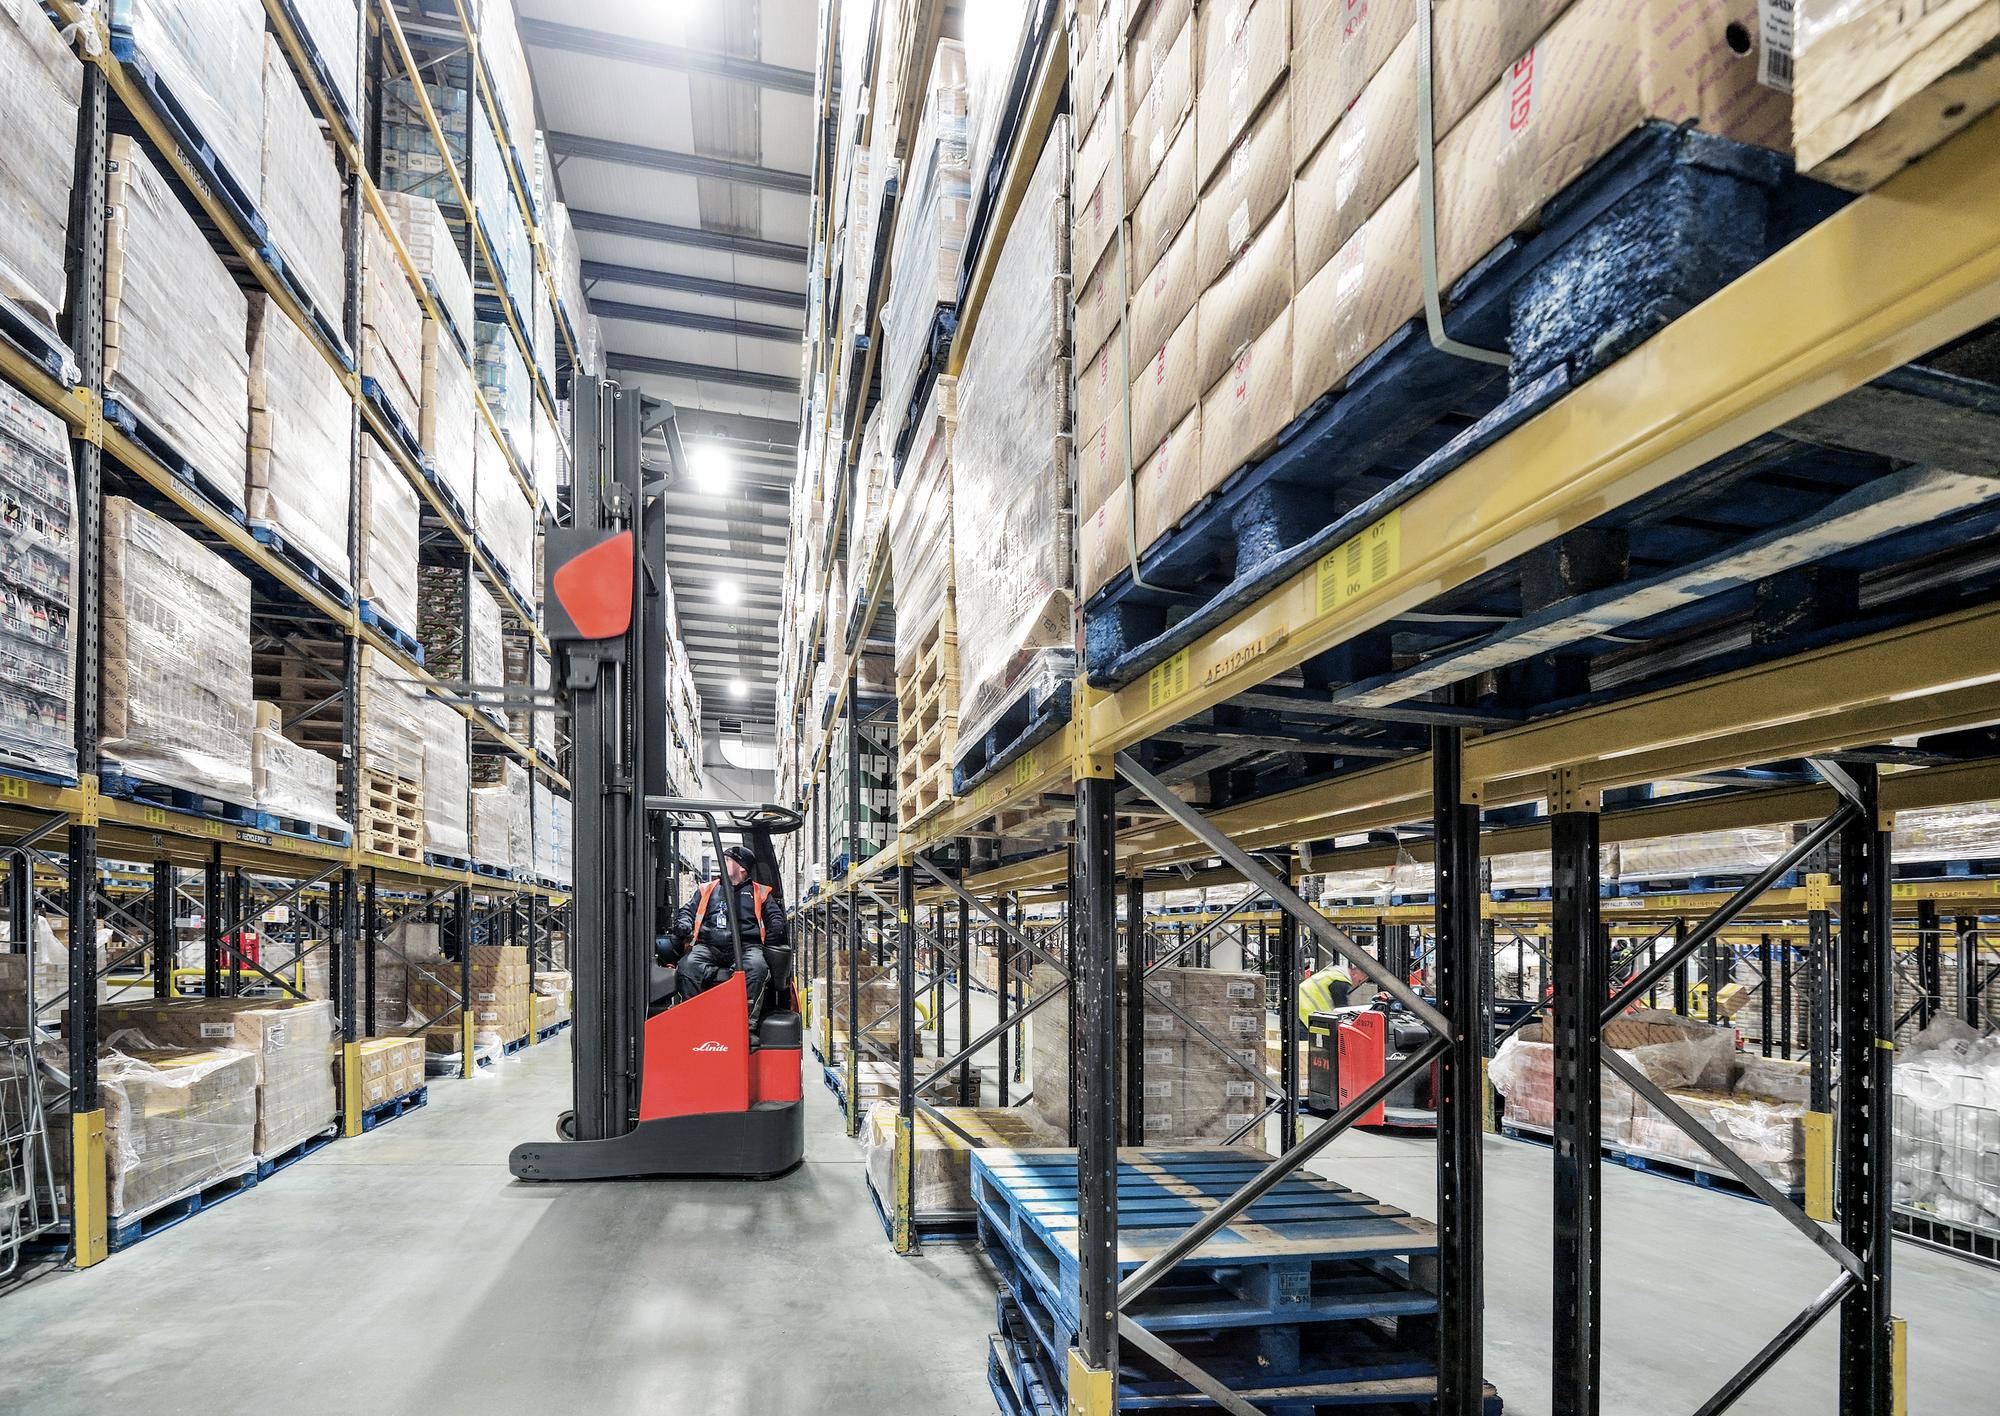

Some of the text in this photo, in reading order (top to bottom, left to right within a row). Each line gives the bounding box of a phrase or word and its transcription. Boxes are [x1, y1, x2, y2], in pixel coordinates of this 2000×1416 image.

[1371, 522, 1387, 540] 07
[1322, 556, 1336, 572] 05
[1345, 582, 1361, 597] 06
[692, 1040, 730, 1053] Linde
